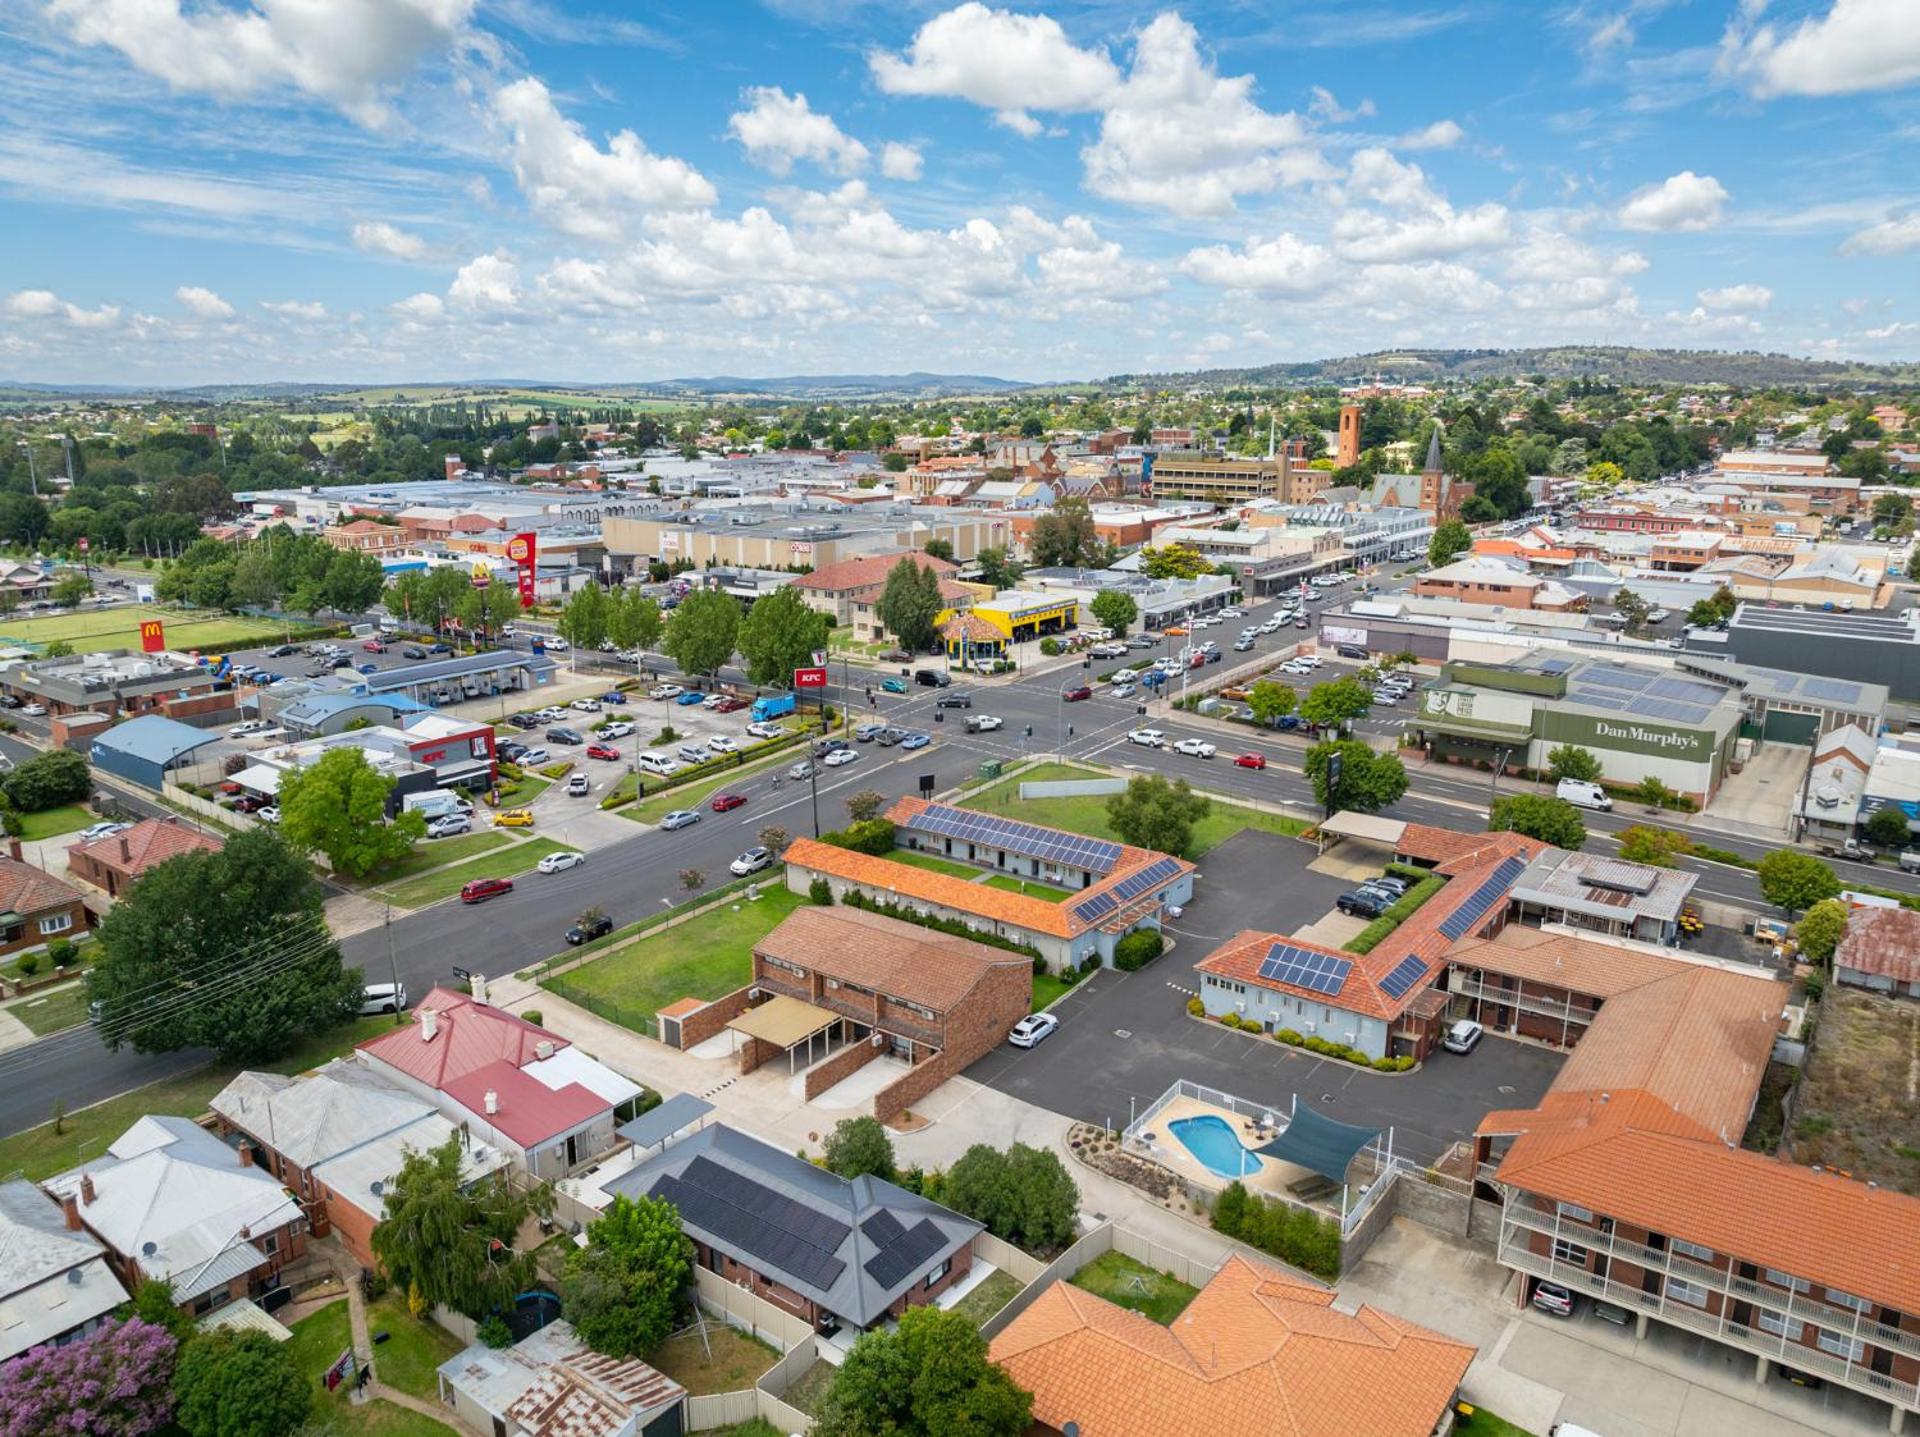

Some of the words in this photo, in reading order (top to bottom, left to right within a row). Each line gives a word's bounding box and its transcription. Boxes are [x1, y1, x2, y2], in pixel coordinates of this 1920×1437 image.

[802, 674, 821, 682] KFC
[1595, 721, 1628, 739] Dan
[1628, 726, 1699, 750] Murphy's
[423, 750, 446, 763] KFC
